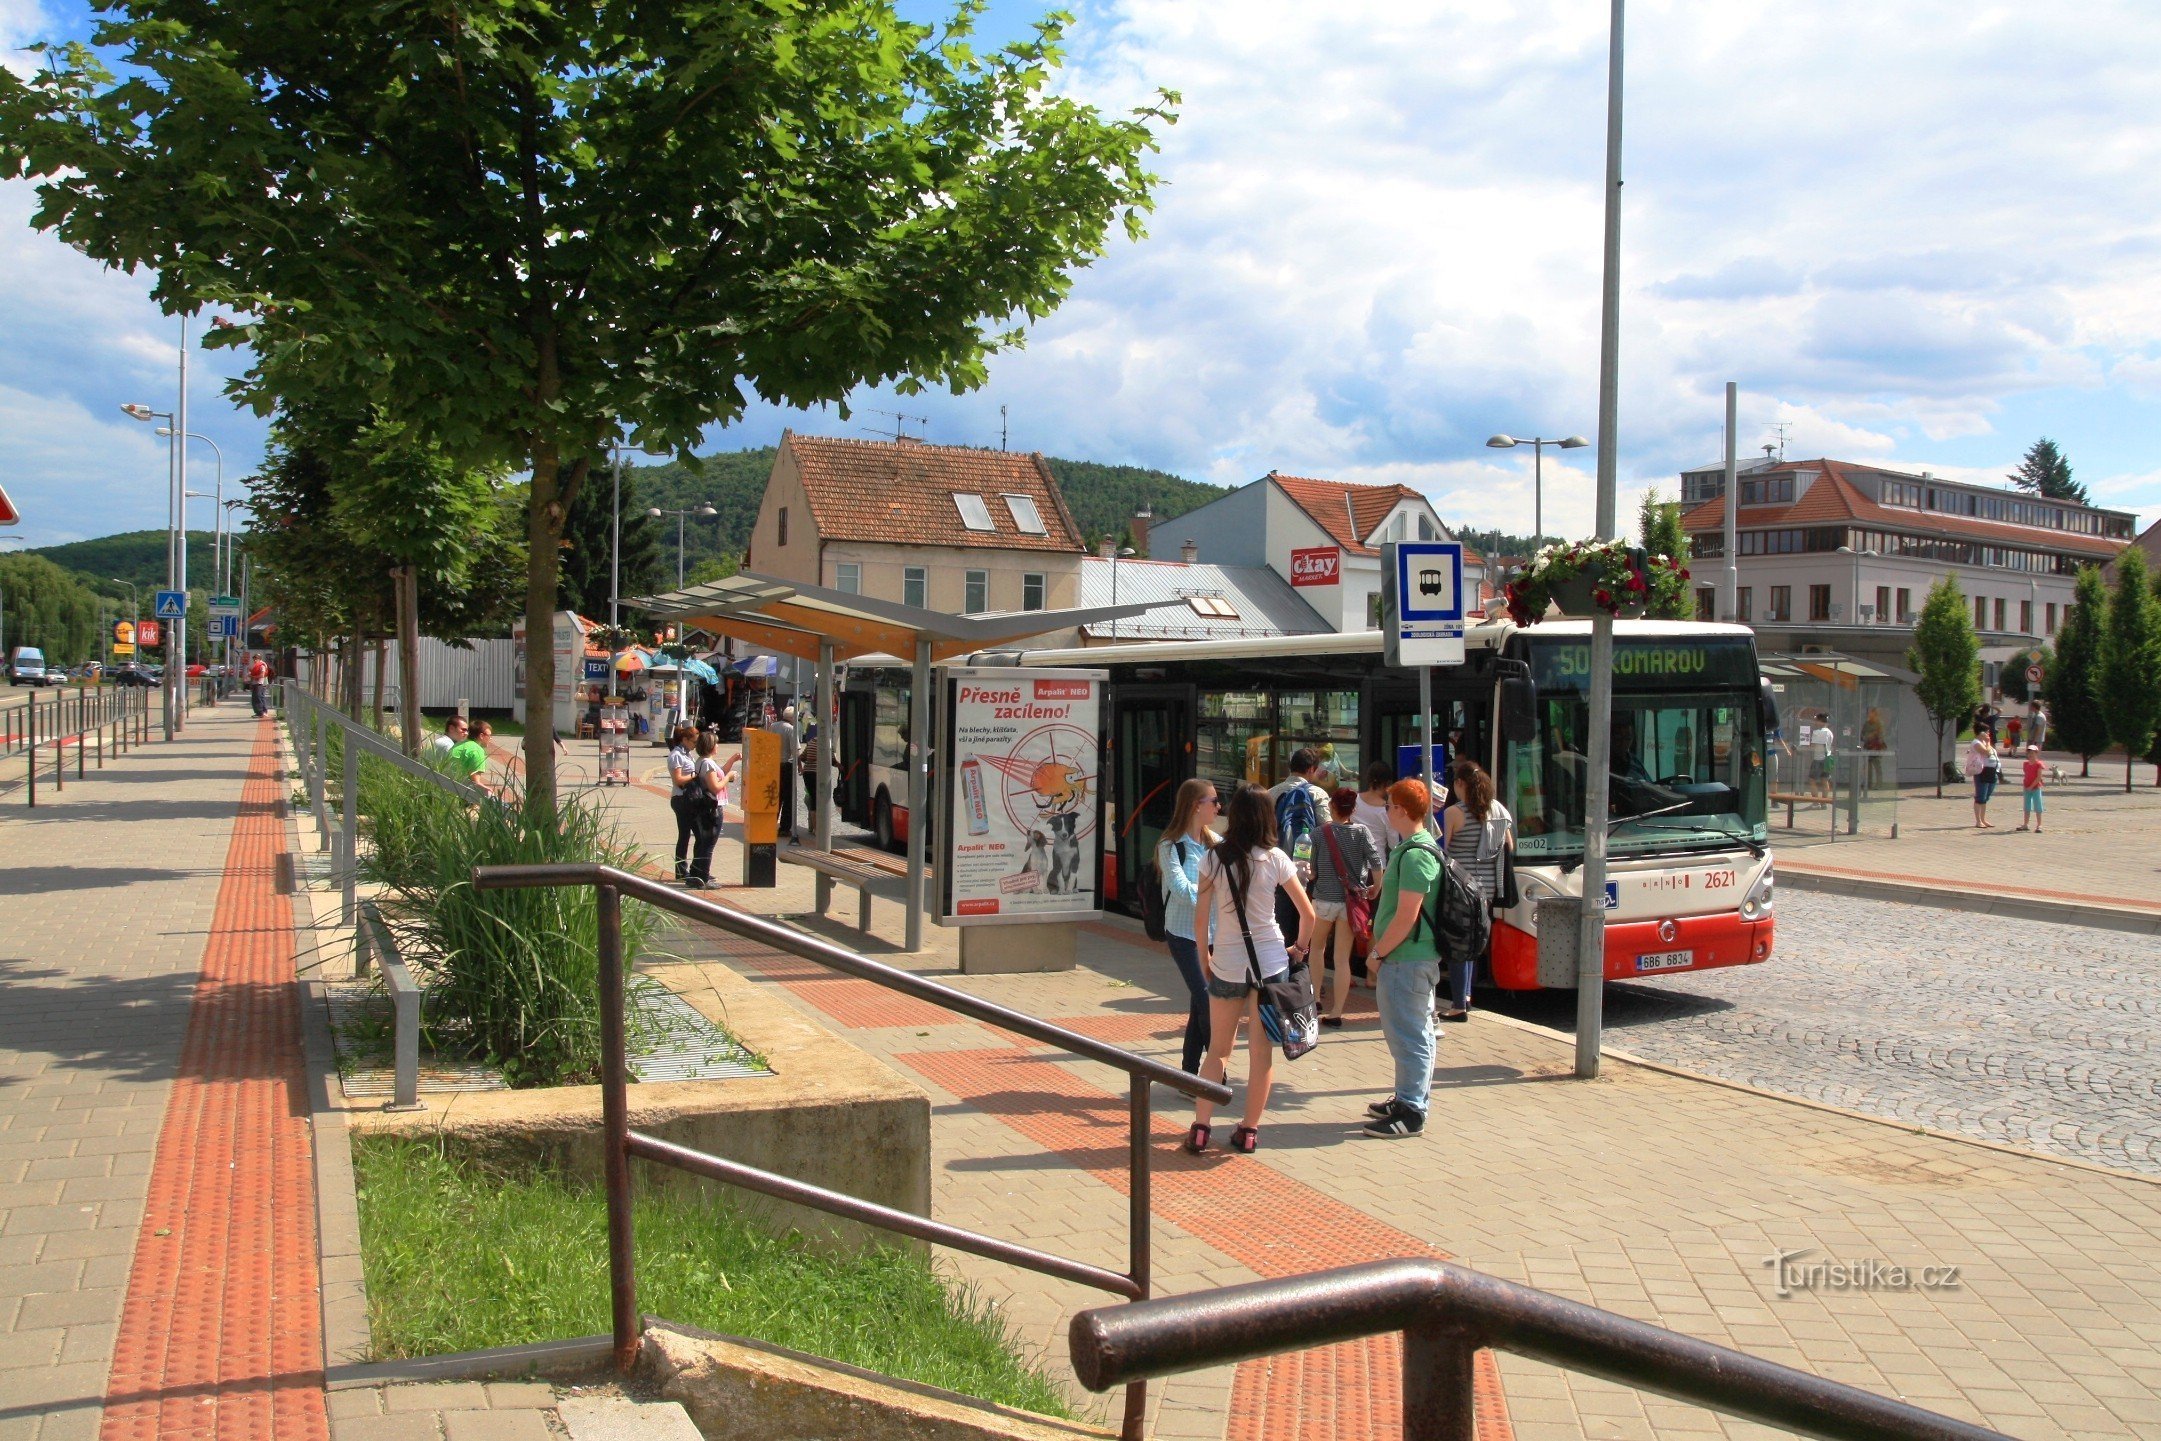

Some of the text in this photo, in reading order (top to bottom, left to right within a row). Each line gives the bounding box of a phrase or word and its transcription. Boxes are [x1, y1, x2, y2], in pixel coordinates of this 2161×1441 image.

[142, 627, 156, 640] kik
[1560, 645, 1589, 675] 50
[959, 687, 1021, 704] Přesně
[1070, 688, 1088, 696] NEO
[994, 703, 1071, 719] zacíleno!
[969, 726, 992, 735] blechy,
[974, 800, 983, 820] NEO
[1704, 870, 1736, 889] 2621
[1643, 952, 1689, 968] 6B6 6834
